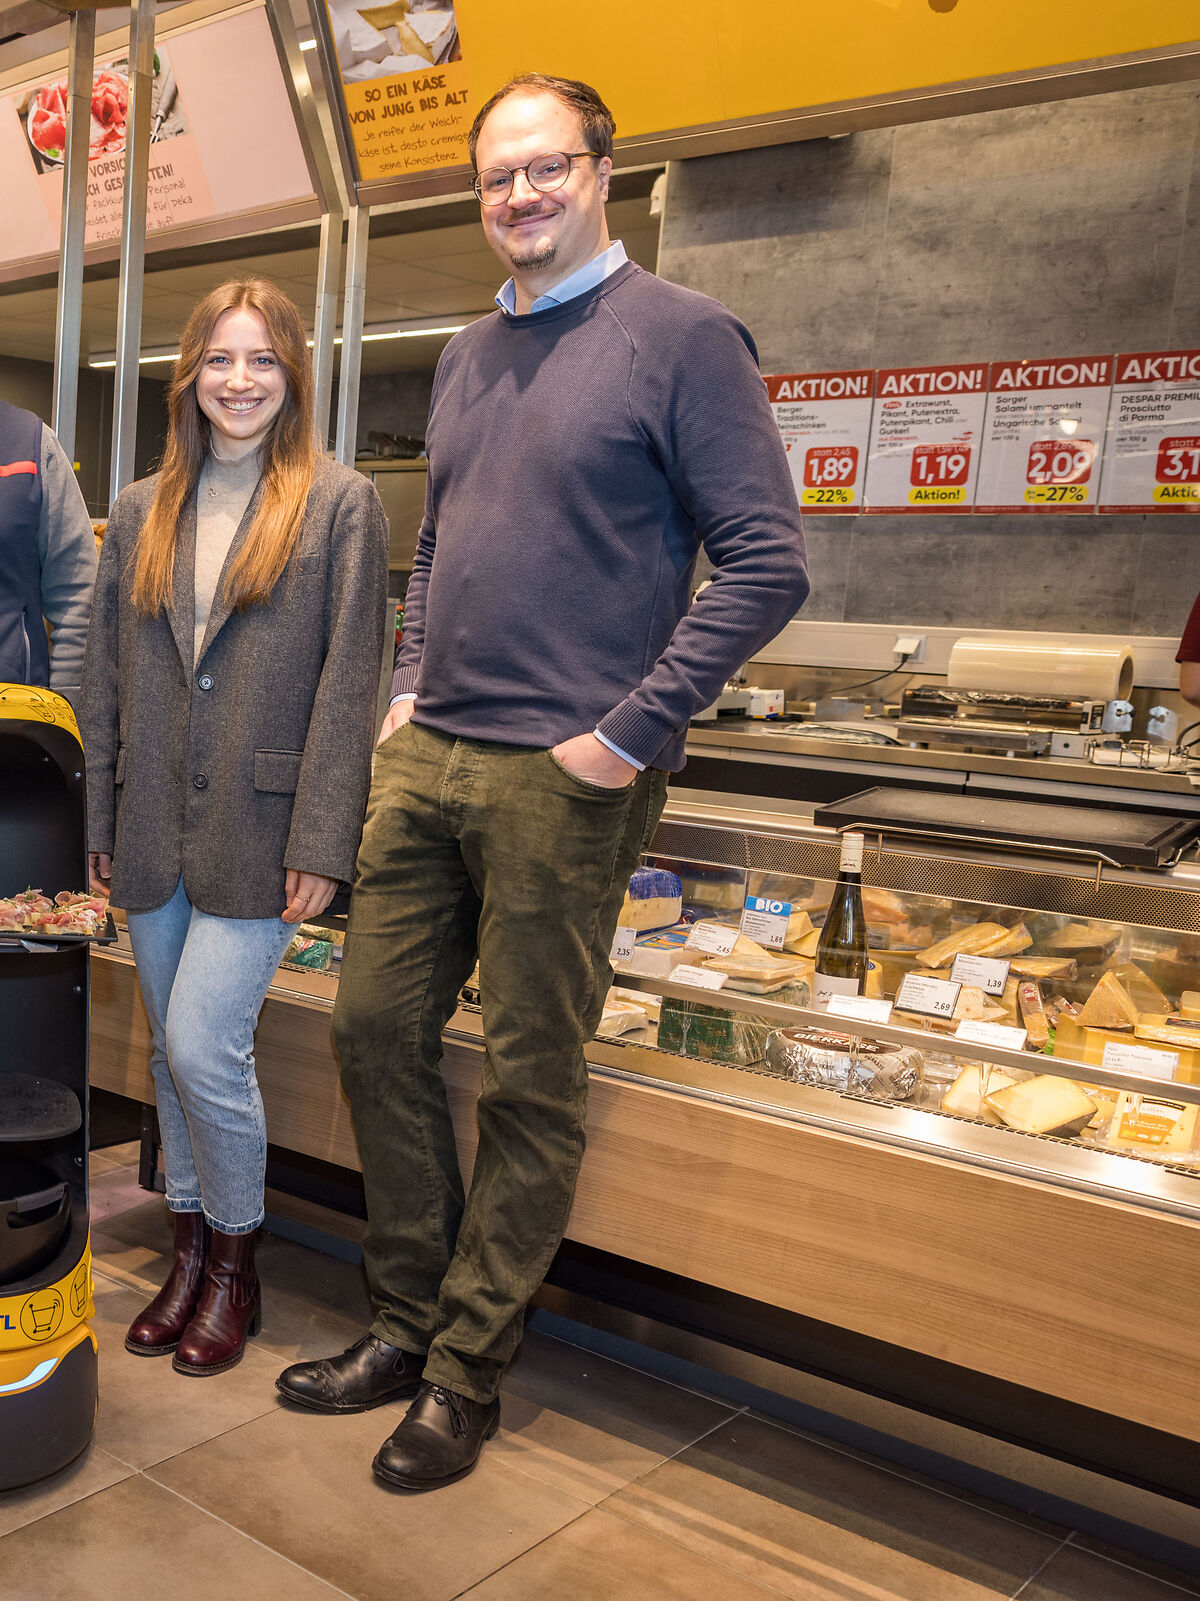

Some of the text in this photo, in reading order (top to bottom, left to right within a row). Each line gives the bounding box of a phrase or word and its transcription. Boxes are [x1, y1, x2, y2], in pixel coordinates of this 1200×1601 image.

[365, 75, 447, 103] SO EIN KÄSE
[349, 90, 469, 124] VON JUNG BIS ALT
[363, 115, 463, 141] Je reifer der Weich-
[359, 132, 470, 158] käse ist, desto cremige
[89, 157, 126, 178] VORSIC
[379, 152, 459, 173] seine Konsistenz
[148, 178, 187, 195] Personal
[153, 201, 168, 212] für
[96, 227, 122, 241] frisch
[995, 362, 1108, 389] AKTION!
[881, 369, 983, 395] AKTION!
[776, 376, 869, 400] AKTION!
[905, 400, 952, 408] Extrawurst,
[996, 396, 1028, 405] Sorger
[1121, 394, 1162, 404] DESPAR
[777, 406, 804, 415] Berger
[911, 408, 960, 417] Putenextra,
[995, 402, 1082, 413] Salami ummantelt
[1120, 404, 1172, 413] Prosciutto
[777, 414, 819, 422] Traditions-
[880, 418, 933, 427] Putenpikant,
[935, 416, 954, 424] Chili
[1119, 413, 1165, 422] di Parma
[993, 419, 1046, 429] Ungarische
[879, 427, 910, 435] Gurkerl
[1169, 439, 1195, 448] statt
[813, 448, 832, 457] statt
[916, 454, 967, 484] 1,19
[1028, 451, 1091, 482] 2,09
[1163, 449, 1200, 481] 3,1
[809, 457, 854, 485] 1,89
[808, 489, 848, 503] -22%
[914, 490, 960, 501] Aktion!
[1036, 486, 1084, 501] -27%
[1160, 486, 1200, 498] Aktio
[755, 898, 784, 914] BIO
[616, 947, 630, 956] 2,35
[716, 945, 731, 954] 2,45
[987, 979, 1002, 988] 1,39
[933, 1001, 951, 1011] 2,69
